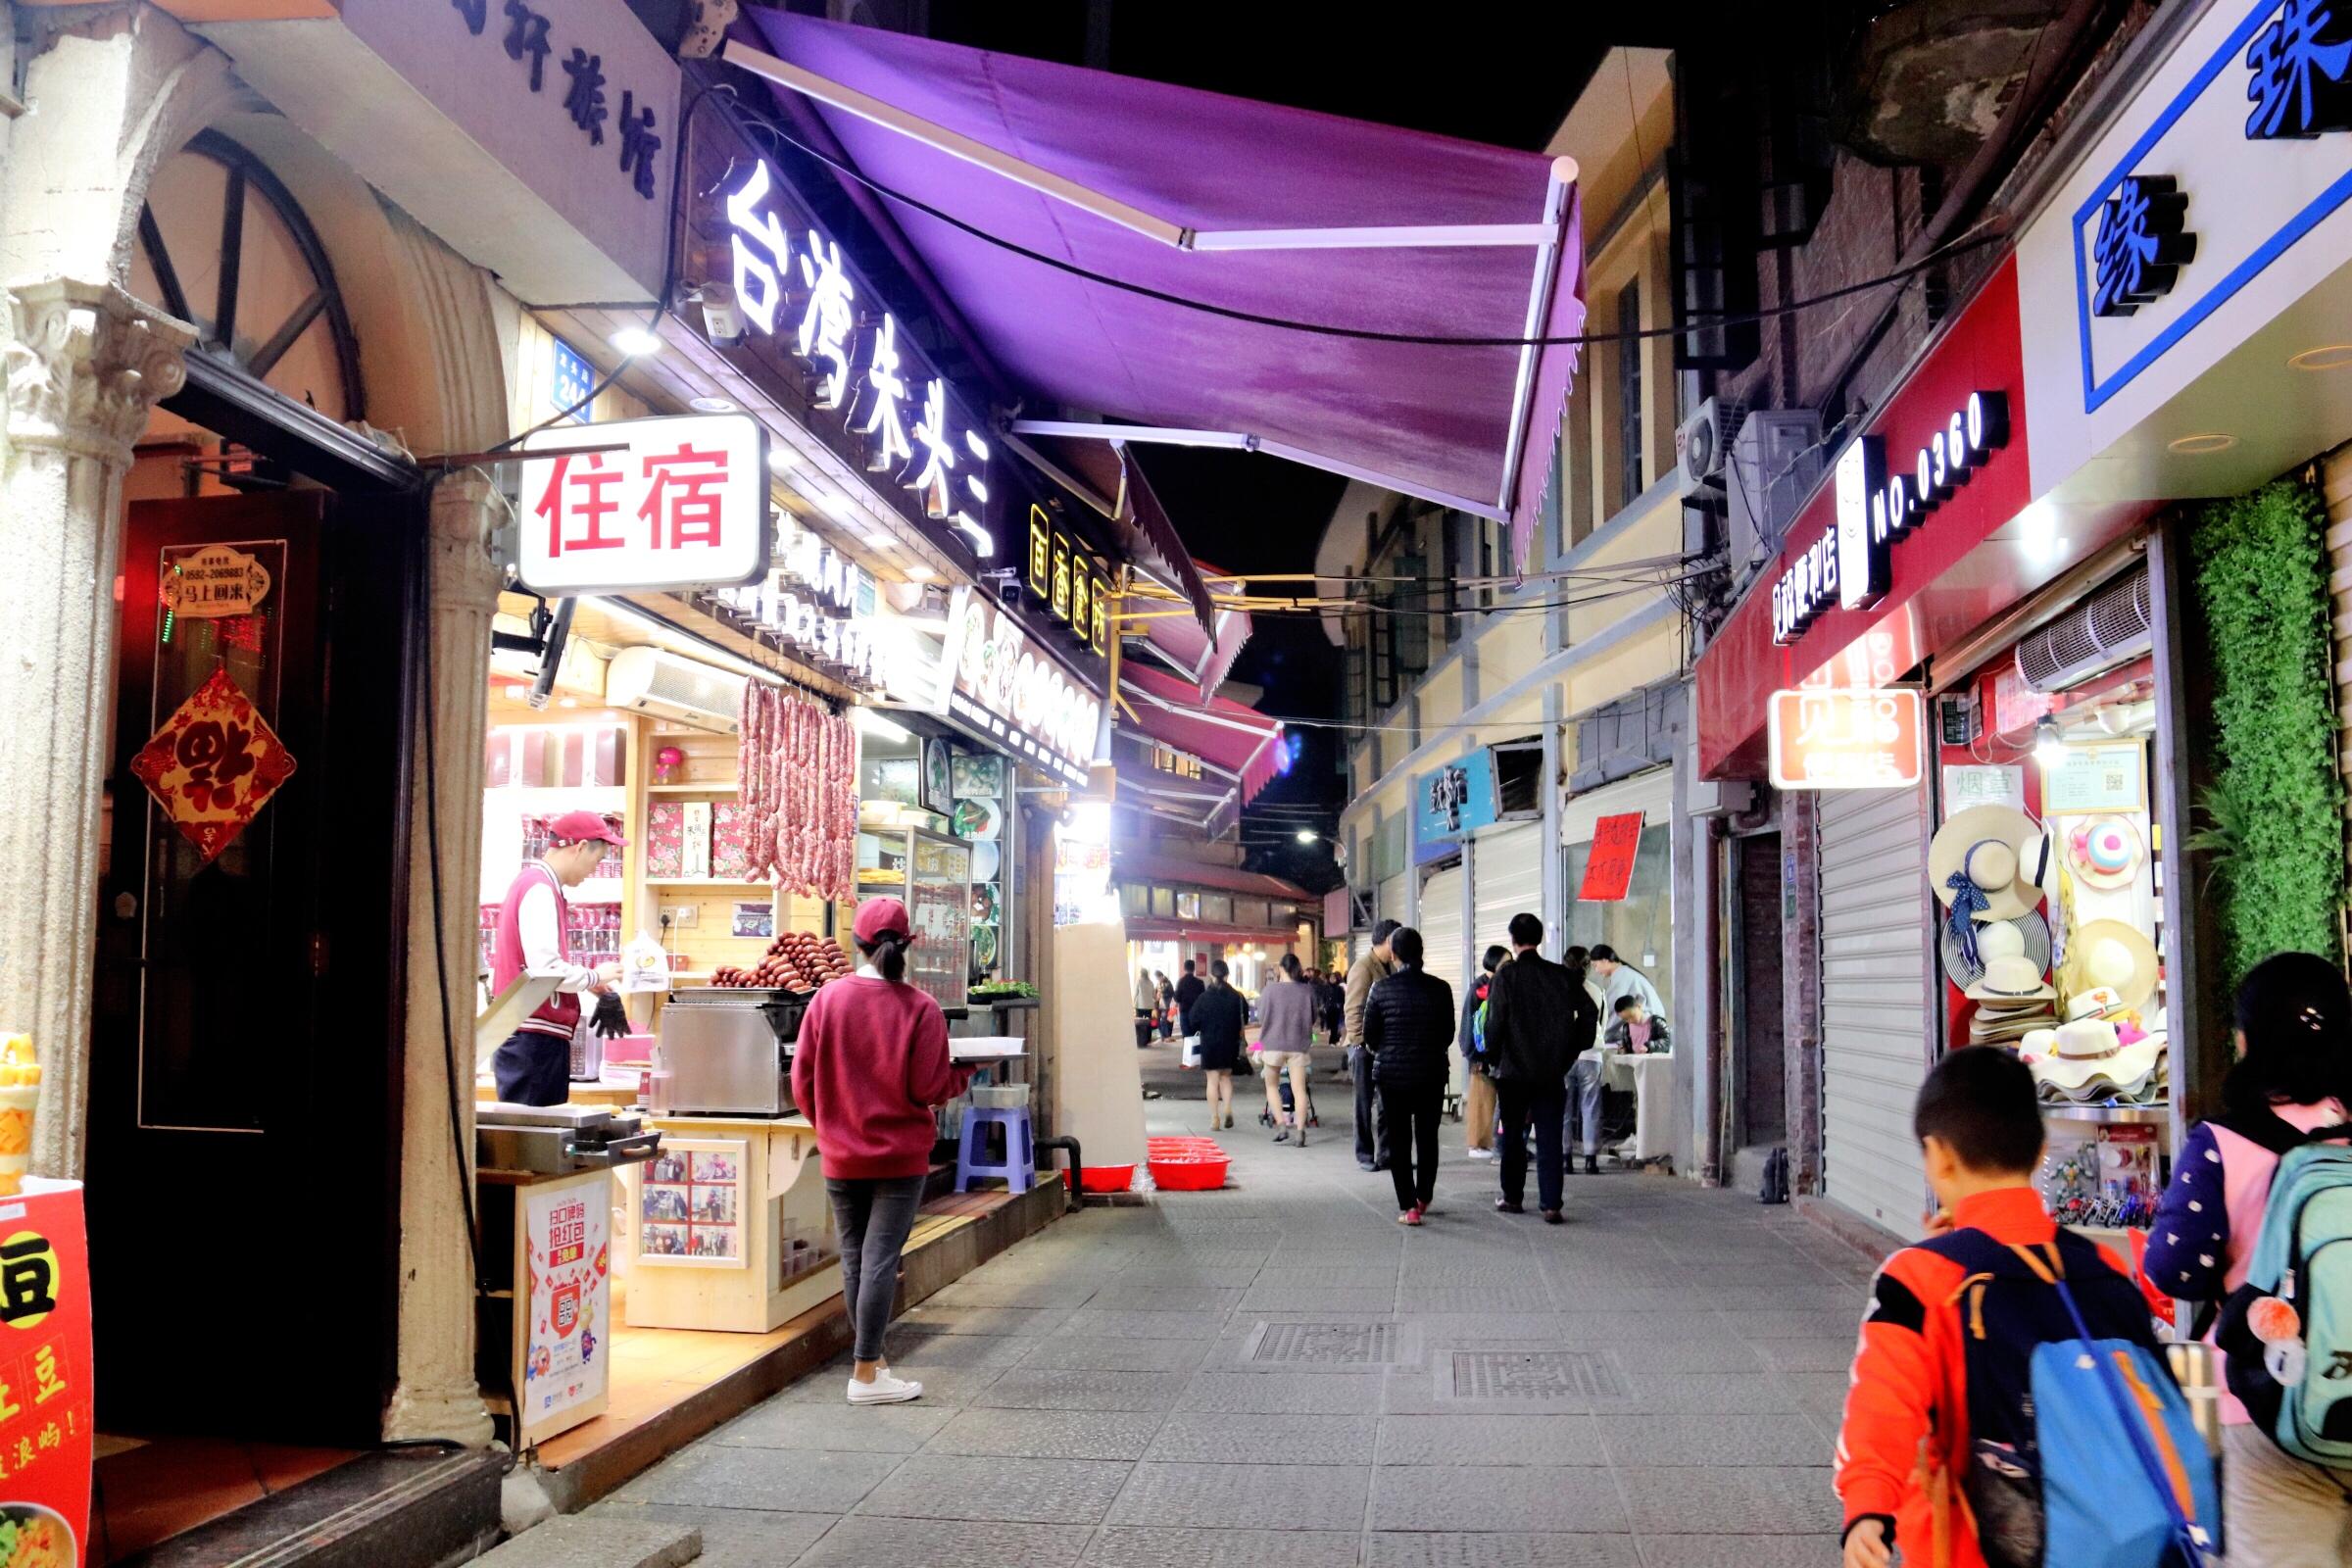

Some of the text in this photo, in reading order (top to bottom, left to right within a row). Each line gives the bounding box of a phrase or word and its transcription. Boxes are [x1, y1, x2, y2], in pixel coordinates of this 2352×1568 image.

[727, 159, 994, 557] 台湾朱头三
[535, 443, 729, 558] 住宿
[1874, 392, 1982, 543] NO.0360
[186, 584, 244, 602] 马上回来
[1957, 770, 2012, 796] 烟草
[549, 1222, 585, 1250] 抢红包
[0, 1238, 56, 1323] 豆
